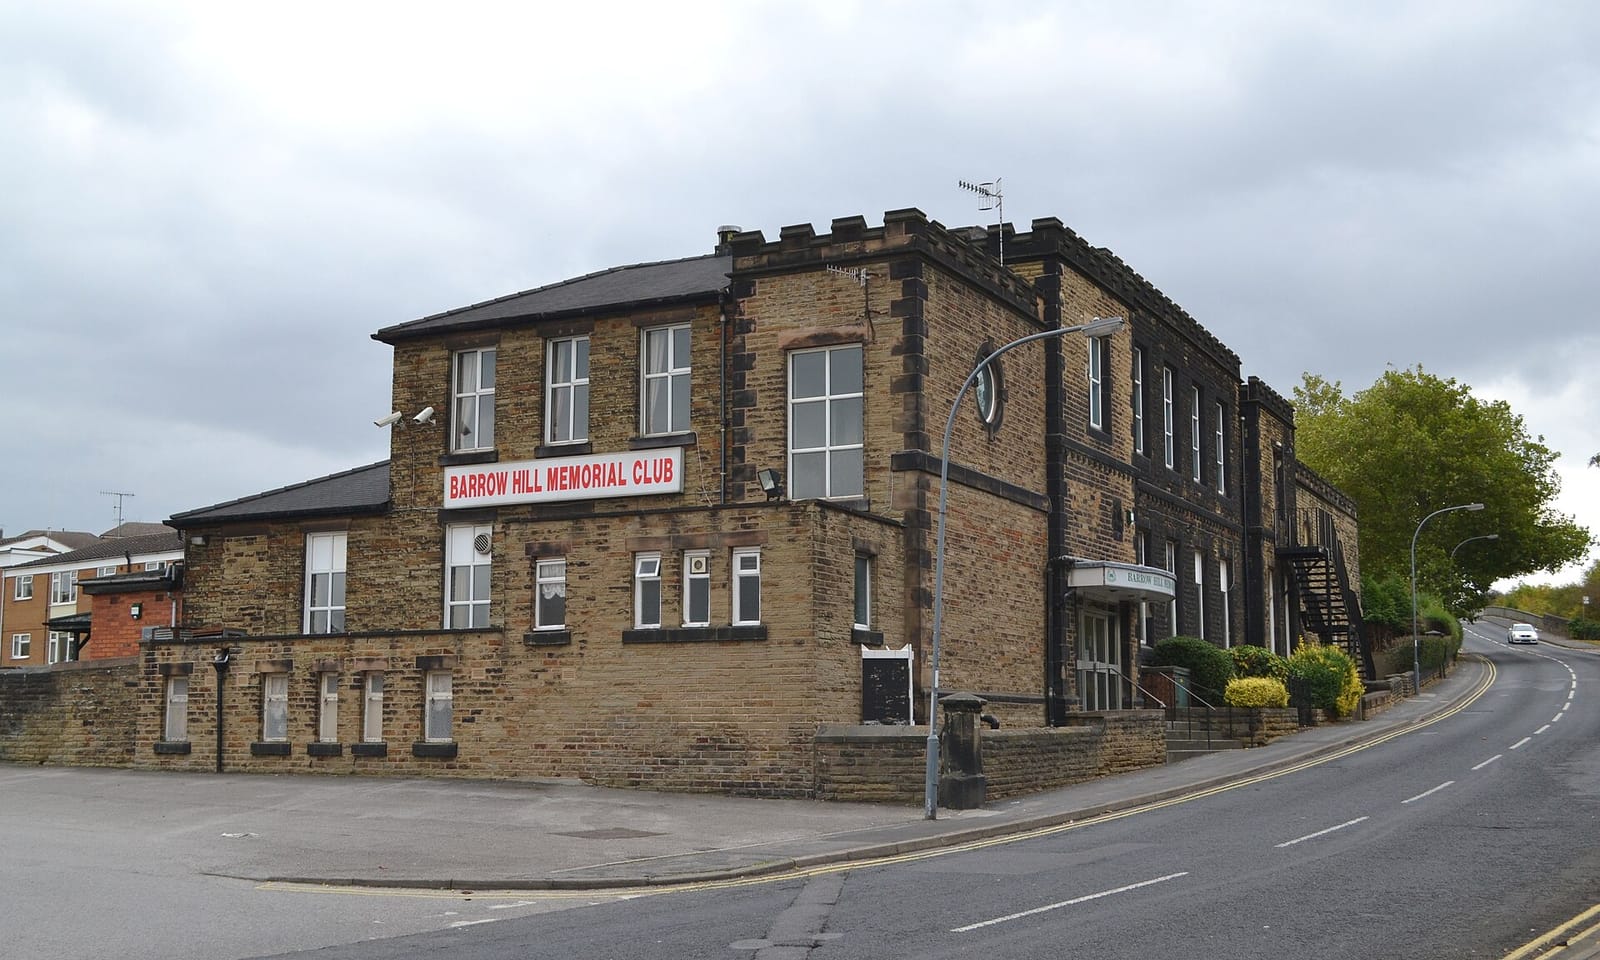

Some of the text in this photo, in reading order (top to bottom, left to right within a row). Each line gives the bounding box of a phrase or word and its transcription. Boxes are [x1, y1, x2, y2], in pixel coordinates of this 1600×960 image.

[450, 458, 673, 499] BARROW HILL MEMORIAL CLUB
[1127, 572, 1152, 584] BARROW
